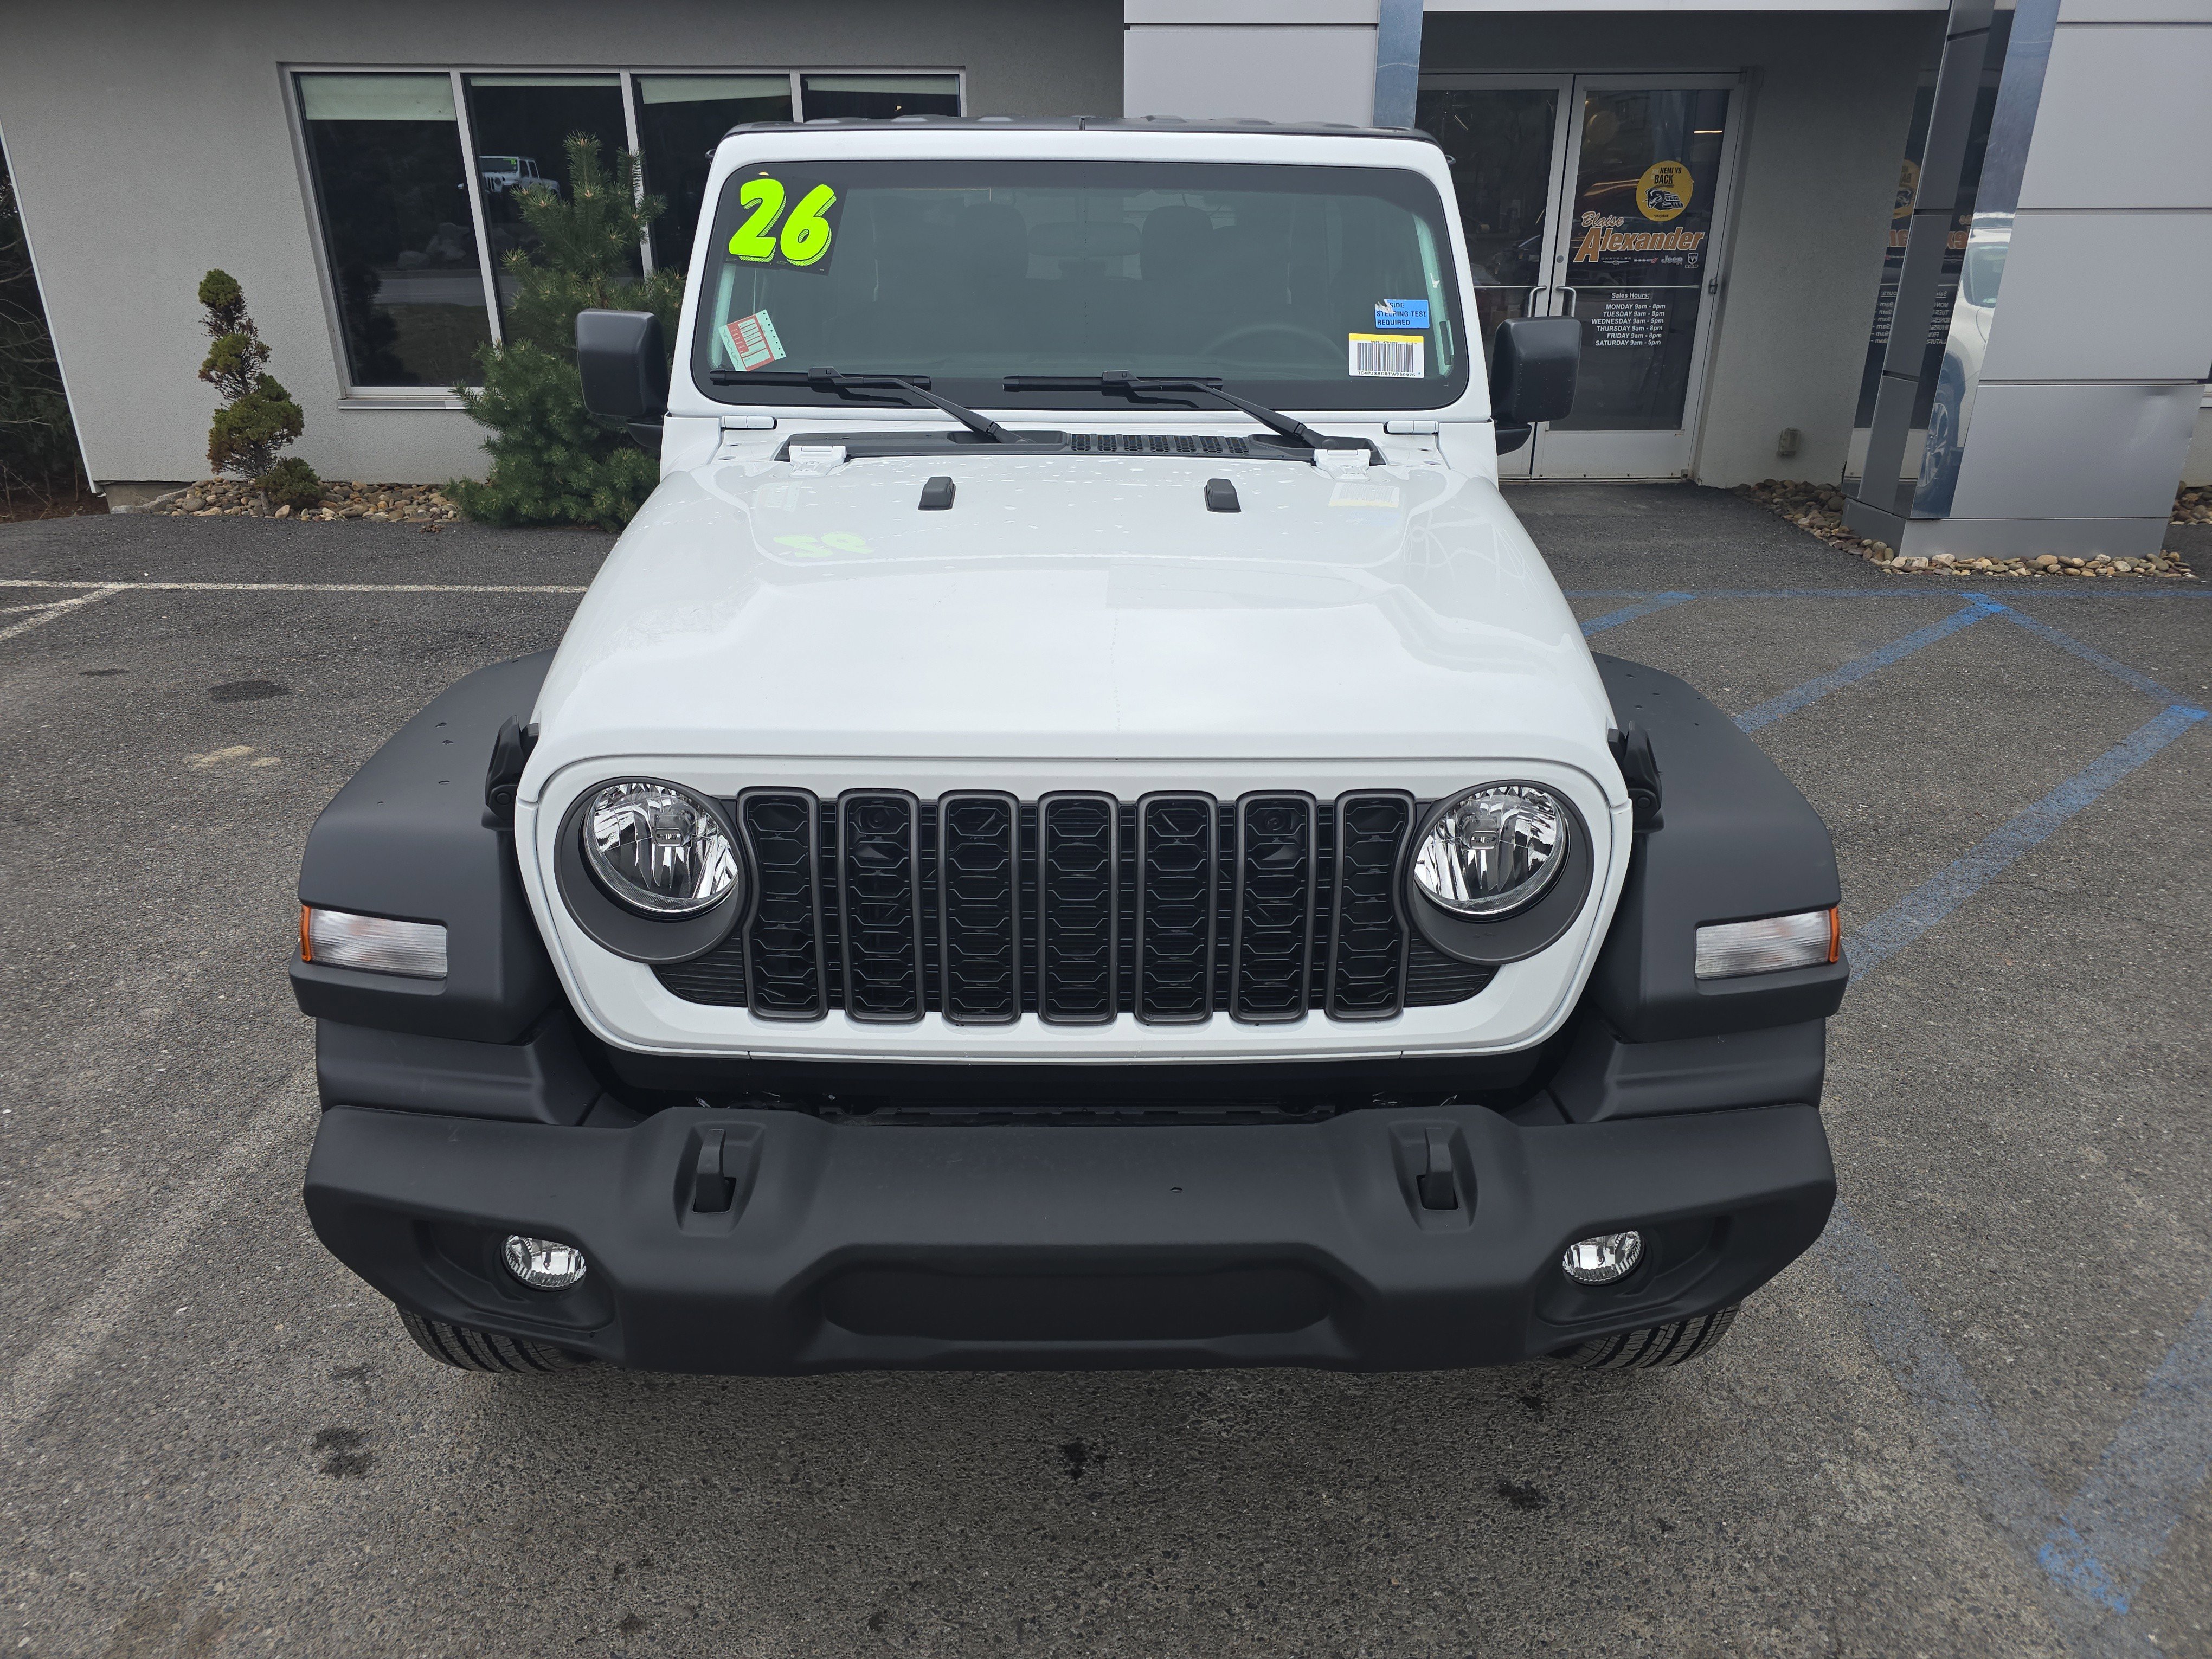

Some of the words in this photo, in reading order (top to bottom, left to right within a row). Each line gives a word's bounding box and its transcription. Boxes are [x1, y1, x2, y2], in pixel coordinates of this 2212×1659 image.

[1654, 174, 1674, 184] BACK
[729, 178, 837, 266] 26
[1581, 211, 1624, 227] Blaise
[1573, 227, 1706, 263] Alexander
[1661, 255, 1683, 264] Jeep
